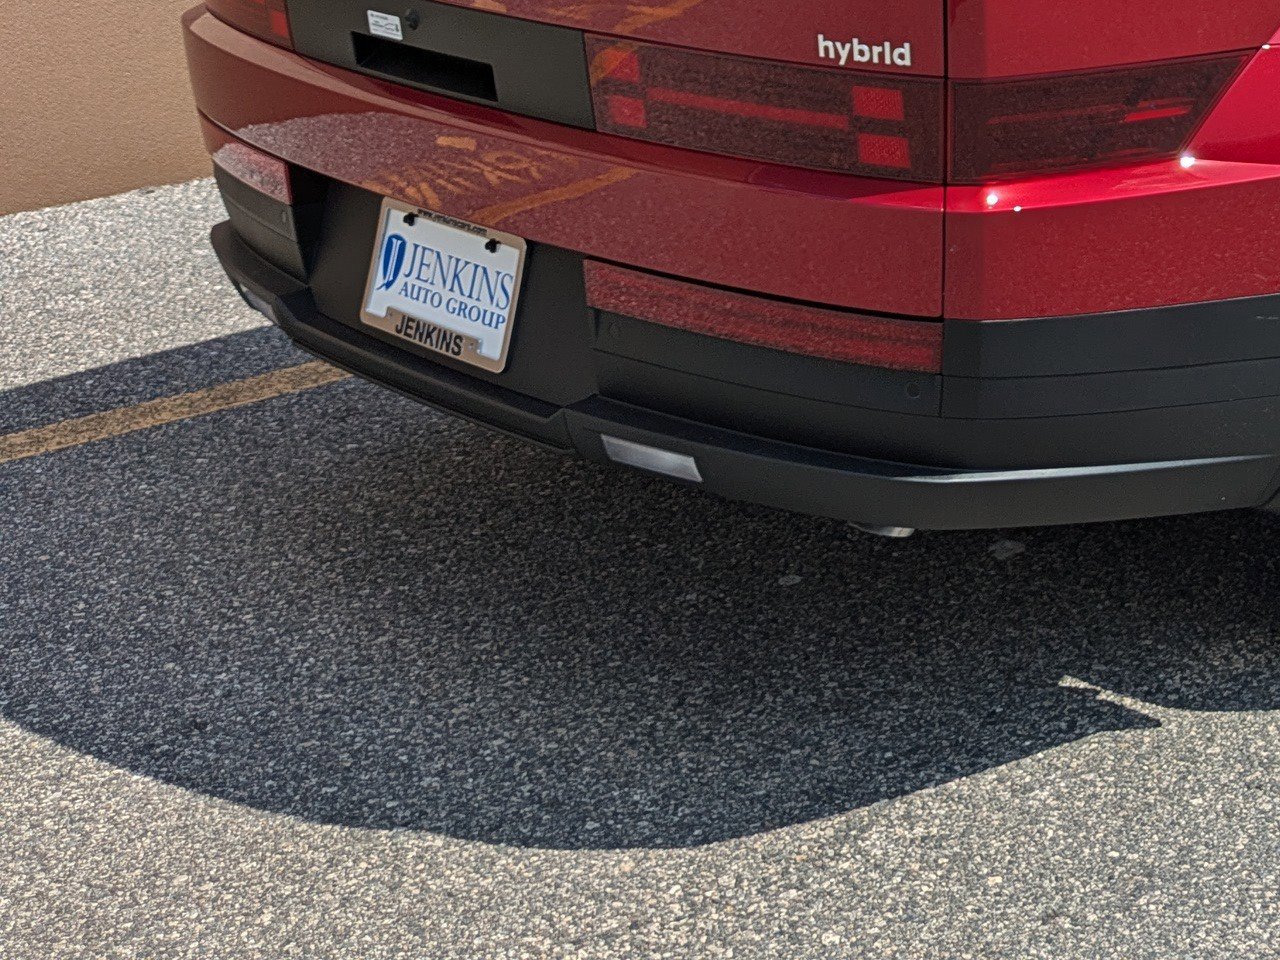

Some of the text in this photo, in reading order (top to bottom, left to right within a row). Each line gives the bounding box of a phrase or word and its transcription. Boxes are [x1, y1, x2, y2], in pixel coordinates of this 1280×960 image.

[817, 33, 912, 66] hybrid
[403, 243, 513, 311] JENKINS
[398, 281, 506, 330] AUTO GROUP
[395, 314, 464, 357] JENKINS
